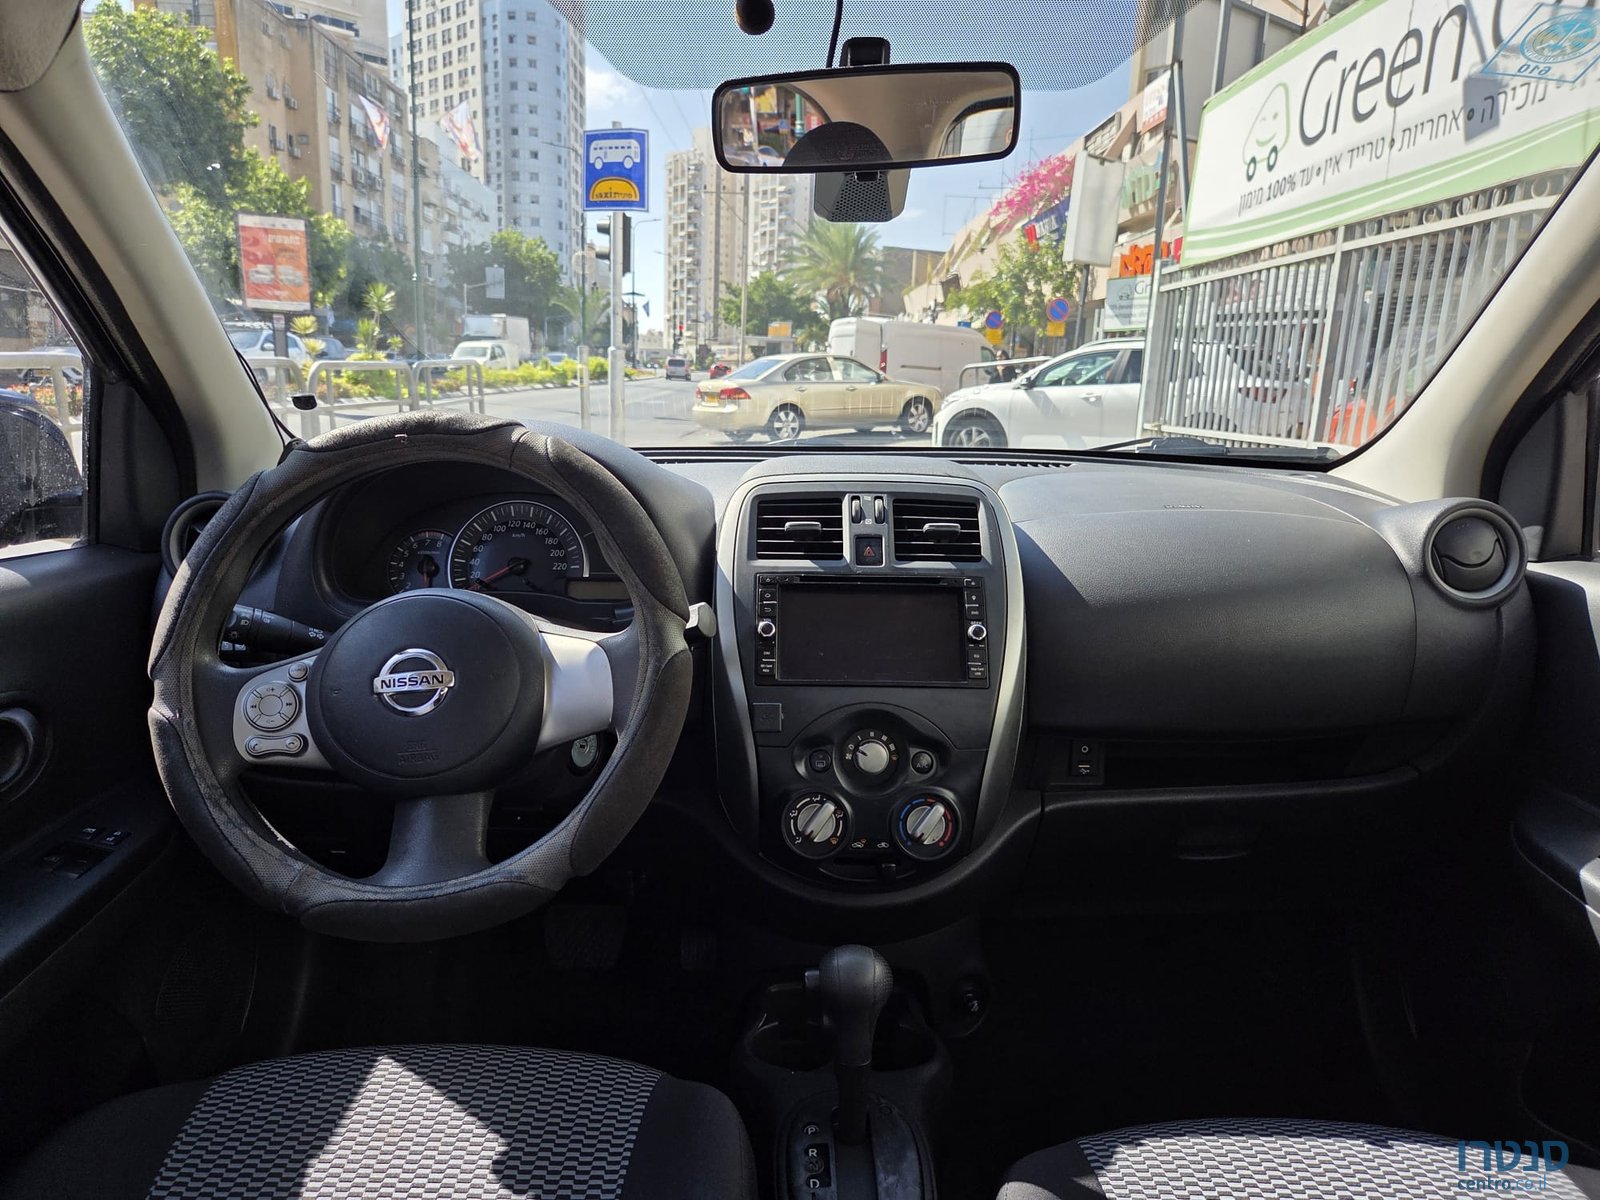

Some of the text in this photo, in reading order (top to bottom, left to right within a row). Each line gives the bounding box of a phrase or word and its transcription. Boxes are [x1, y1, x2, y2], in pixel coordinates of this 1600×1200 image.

[1299, 4, 1468, 147] Green
[1480, 80, 1548, 124] מכירה
[1398, 106, 1465, 152] אחריות
[1346, 137, 1386, 169] טרייד
[1322, 153, 1343, 186] אין
[1299, 166, 1315, 188] עד
[1266, 172, 1297, 202] 100%
[1238, 186, 1264, 218] מימון
[508, 520, 521, 528] 120
[523, 521, 536, 529] 140
[493, 525, 507, 533] 100
[481, 533, 493, 541] 80
[544, 537, 558, 545] 180
[412, 541, 418, 549] 6
[472, 545, 484, 553] 60
[403, 550, 409, 558] 5
[550, 549, 565, 557] 200
[469, 558, 480, 566] 40
[470, 571, 480, 579] 20
[380, 674, 444, 690] NISSAN
[808, 1127, 816, 1135] P
[808, 1148, 818, 1157] R
[809, 1178, 820, 1189] D
